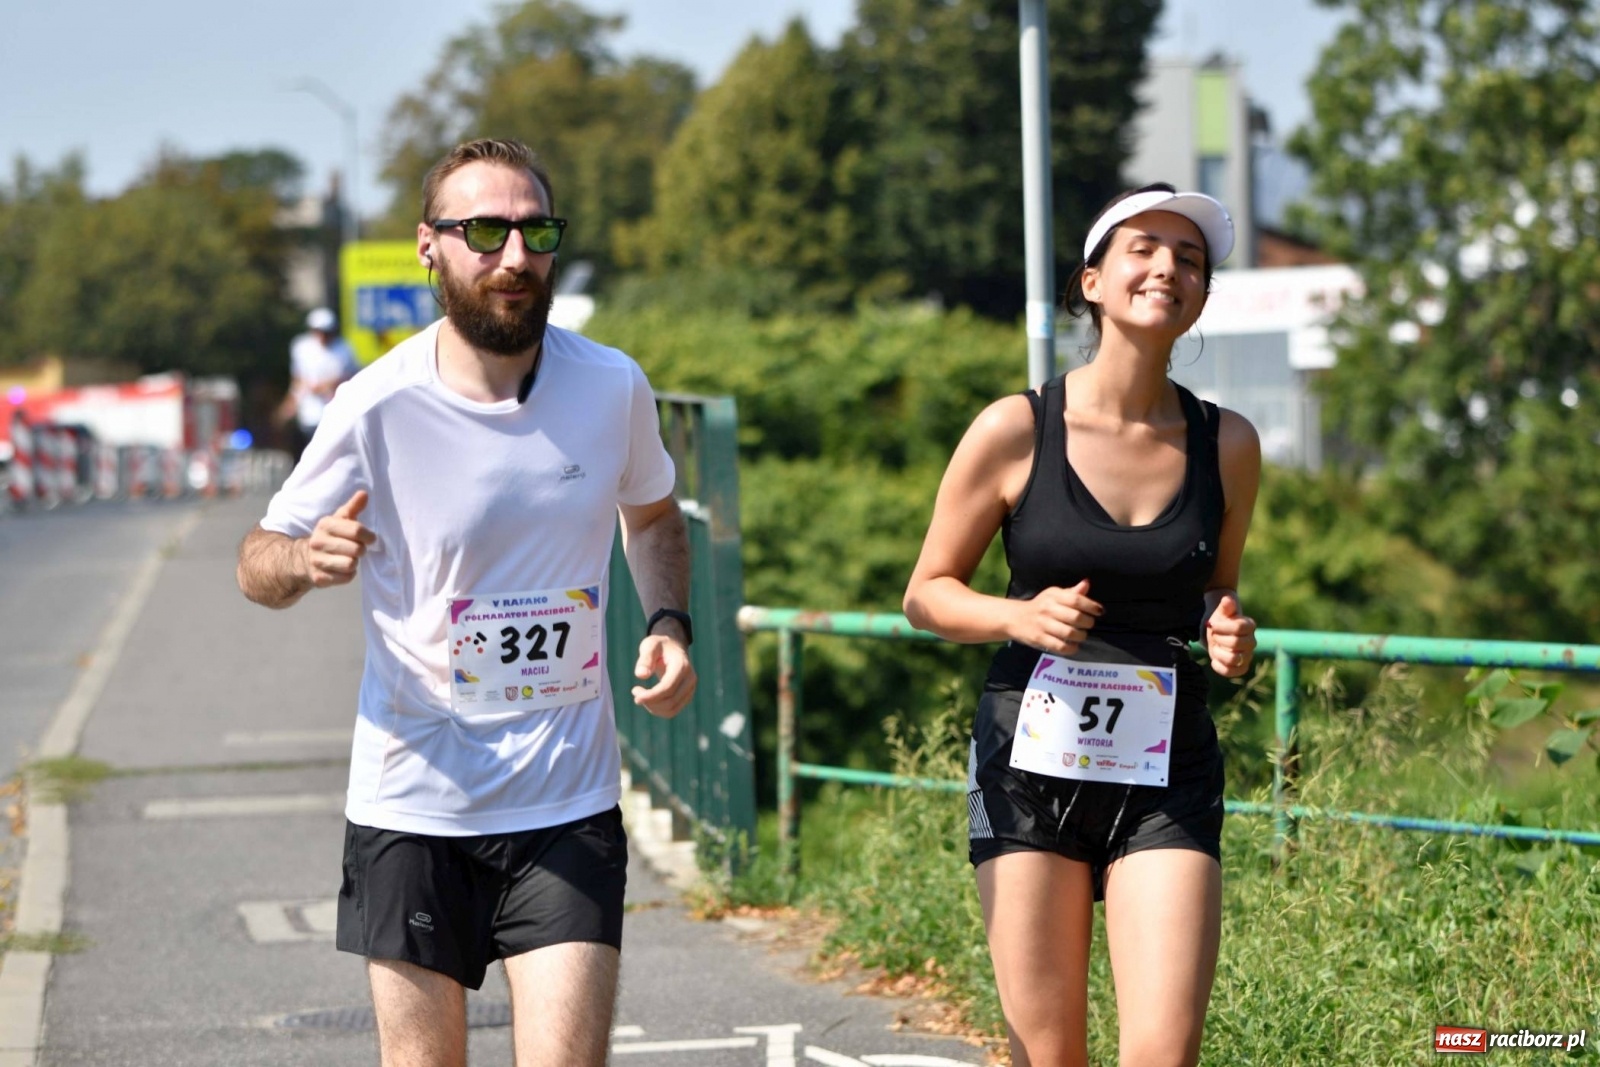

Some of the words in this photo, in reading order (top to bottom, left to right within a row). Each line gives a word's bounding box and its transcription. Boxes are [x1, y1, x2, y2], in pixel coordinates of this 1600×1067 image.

[492, 599, 500, 608] V
[503, 596, 548, 607] RAFAKO
[500, 621, 571, 664] 327
[521, 665, 550, 676] MACIEJ
[1067, 667, 1075, 675] V
[1077, 668, 1119, 678] RAFAKO
[1078, 696, 1124, 734] 57
[1077, 737, 1113, 748] WIKTORIA
